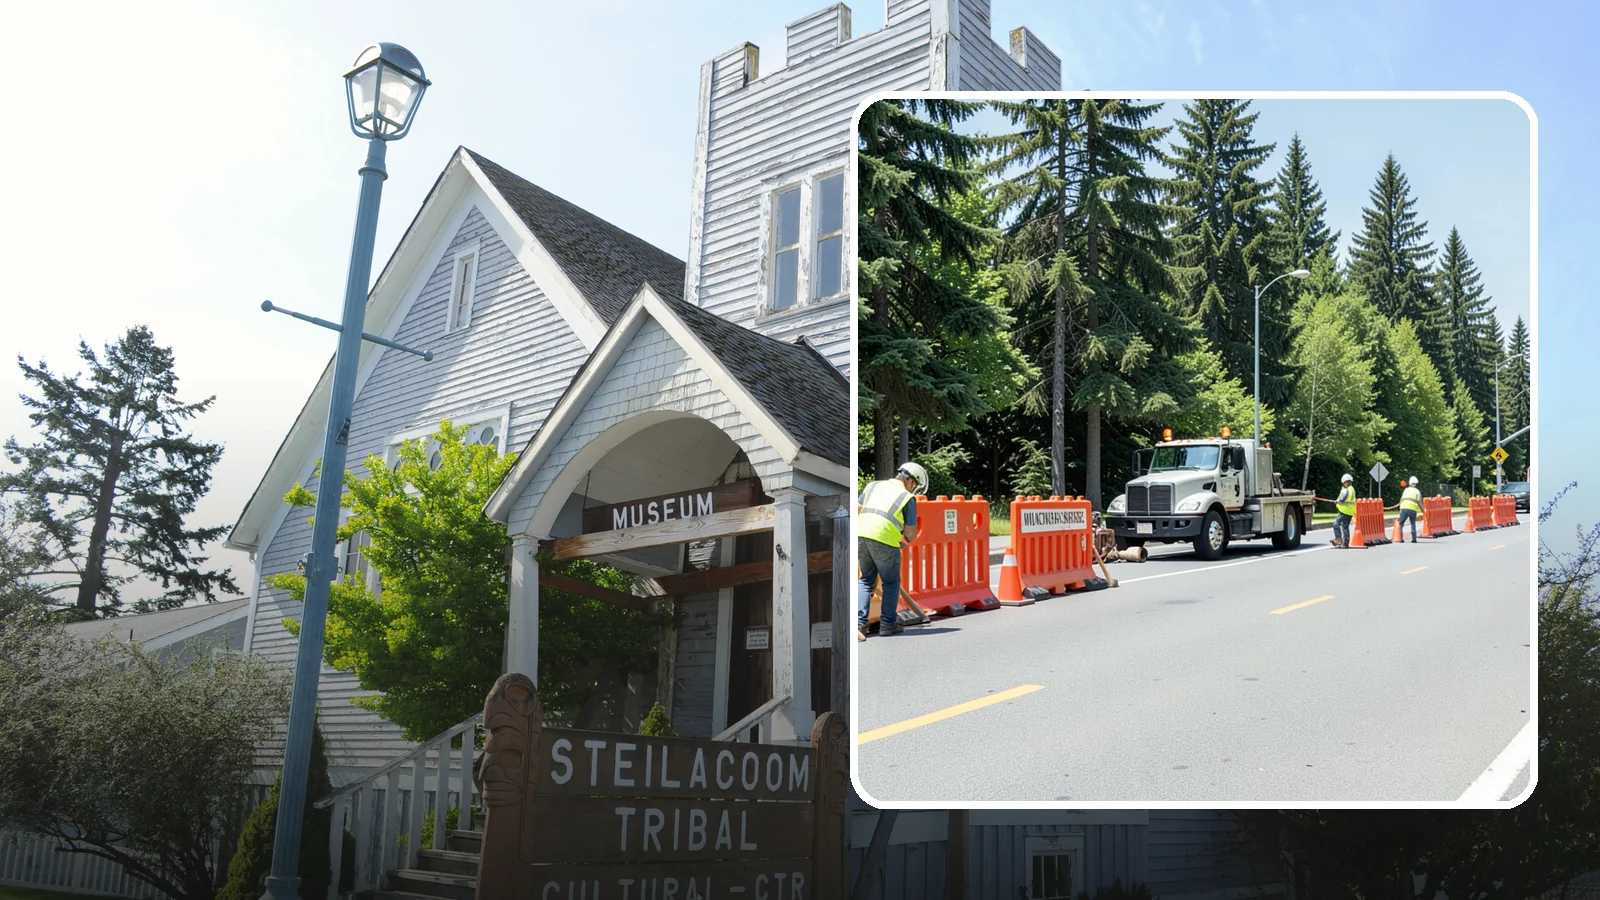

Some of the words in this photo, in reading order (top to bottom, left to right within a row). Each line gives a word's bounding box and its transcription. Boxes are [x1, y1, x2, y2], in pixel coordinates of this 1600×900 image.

[612, 491, 713, 530] MUSEUM
[550, 737, 810, 793] STEILACOOM
[614, 806, 758, 852] TRIBAL
